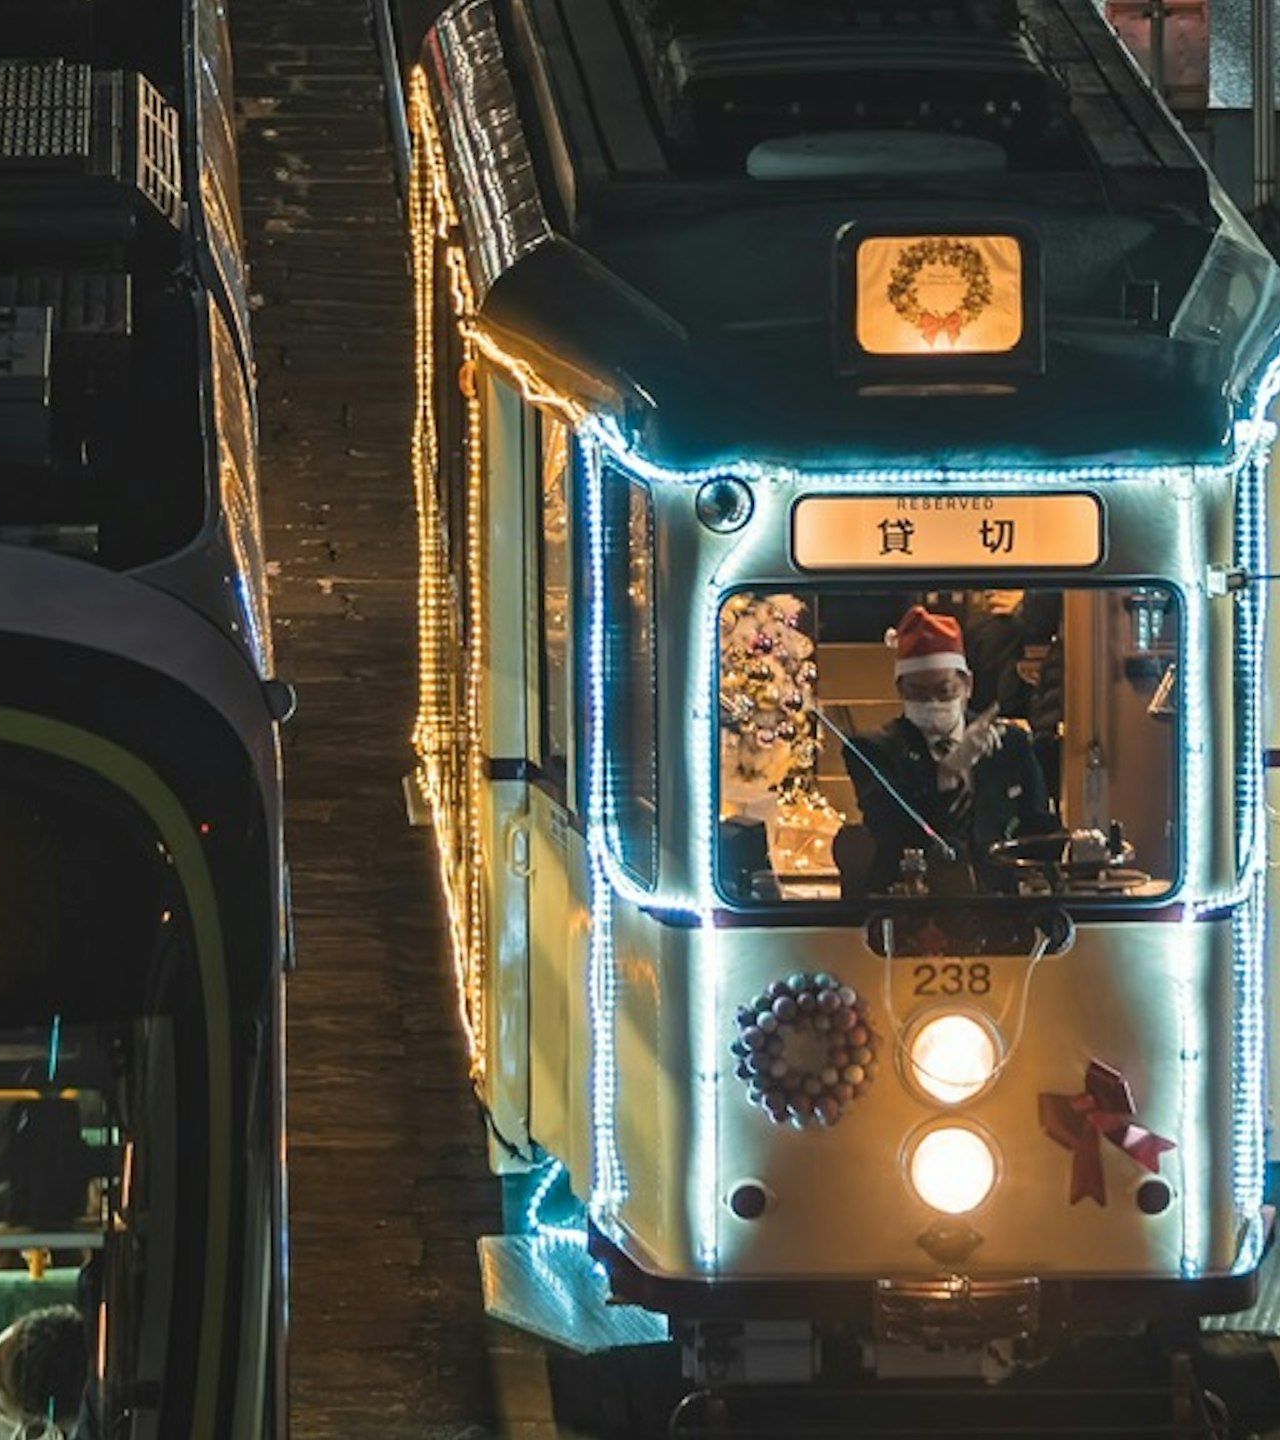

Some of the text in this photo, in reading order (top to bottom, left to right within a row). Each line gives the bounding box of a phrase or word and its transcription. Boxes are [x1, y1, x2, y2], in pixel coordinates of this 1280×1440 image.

[896, 498, 994, 511] RESERVED
[877, 517, 1015, 556] 貸切
[913, 963, 991, 996] 238
